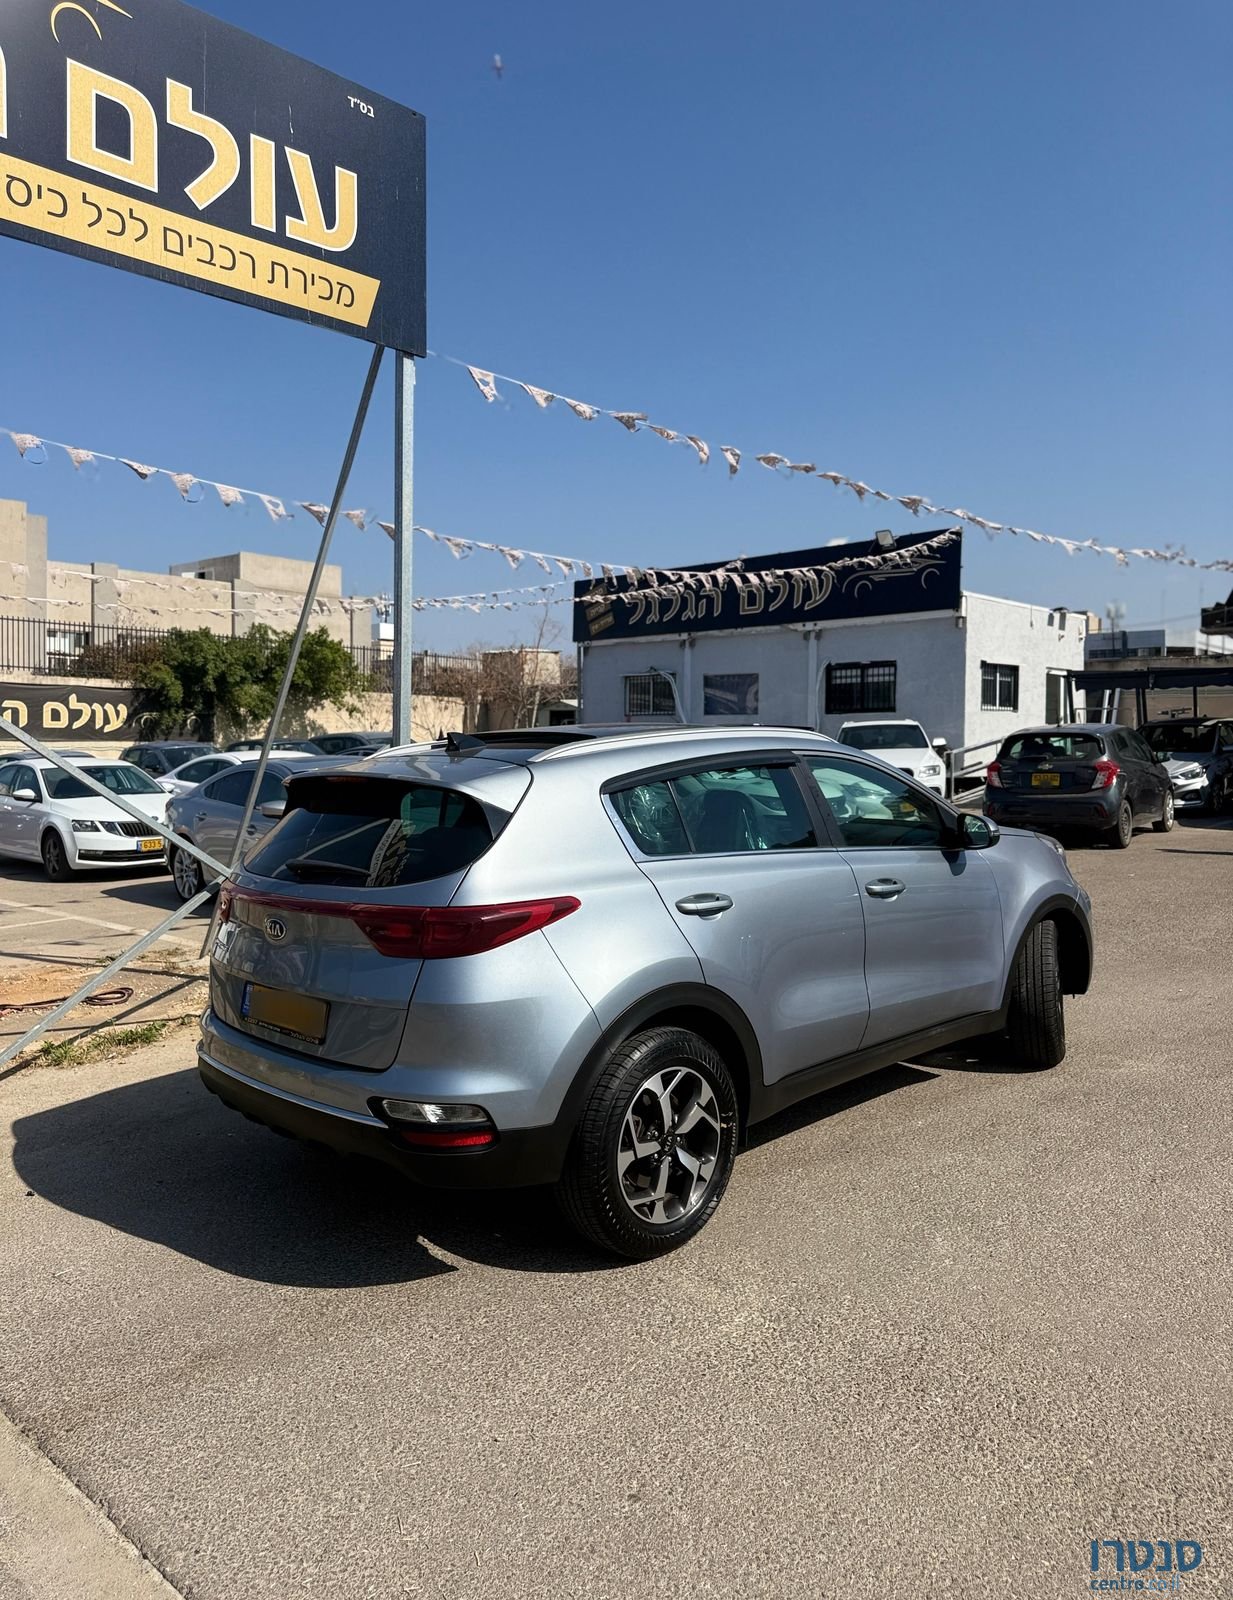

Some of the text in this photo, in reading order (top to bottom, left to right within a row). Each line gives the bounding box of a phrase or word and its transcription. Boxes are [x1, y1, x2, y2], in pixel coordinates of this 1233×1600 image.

[66, 57, 358, 252] עולם
[6, 174, 355, 308] מכירת רכבים לכל כיס
[740, 570, 833, 615] עולם
[43, 693, 128, 733] עולם
[266, 922, 282, 936] KIA
